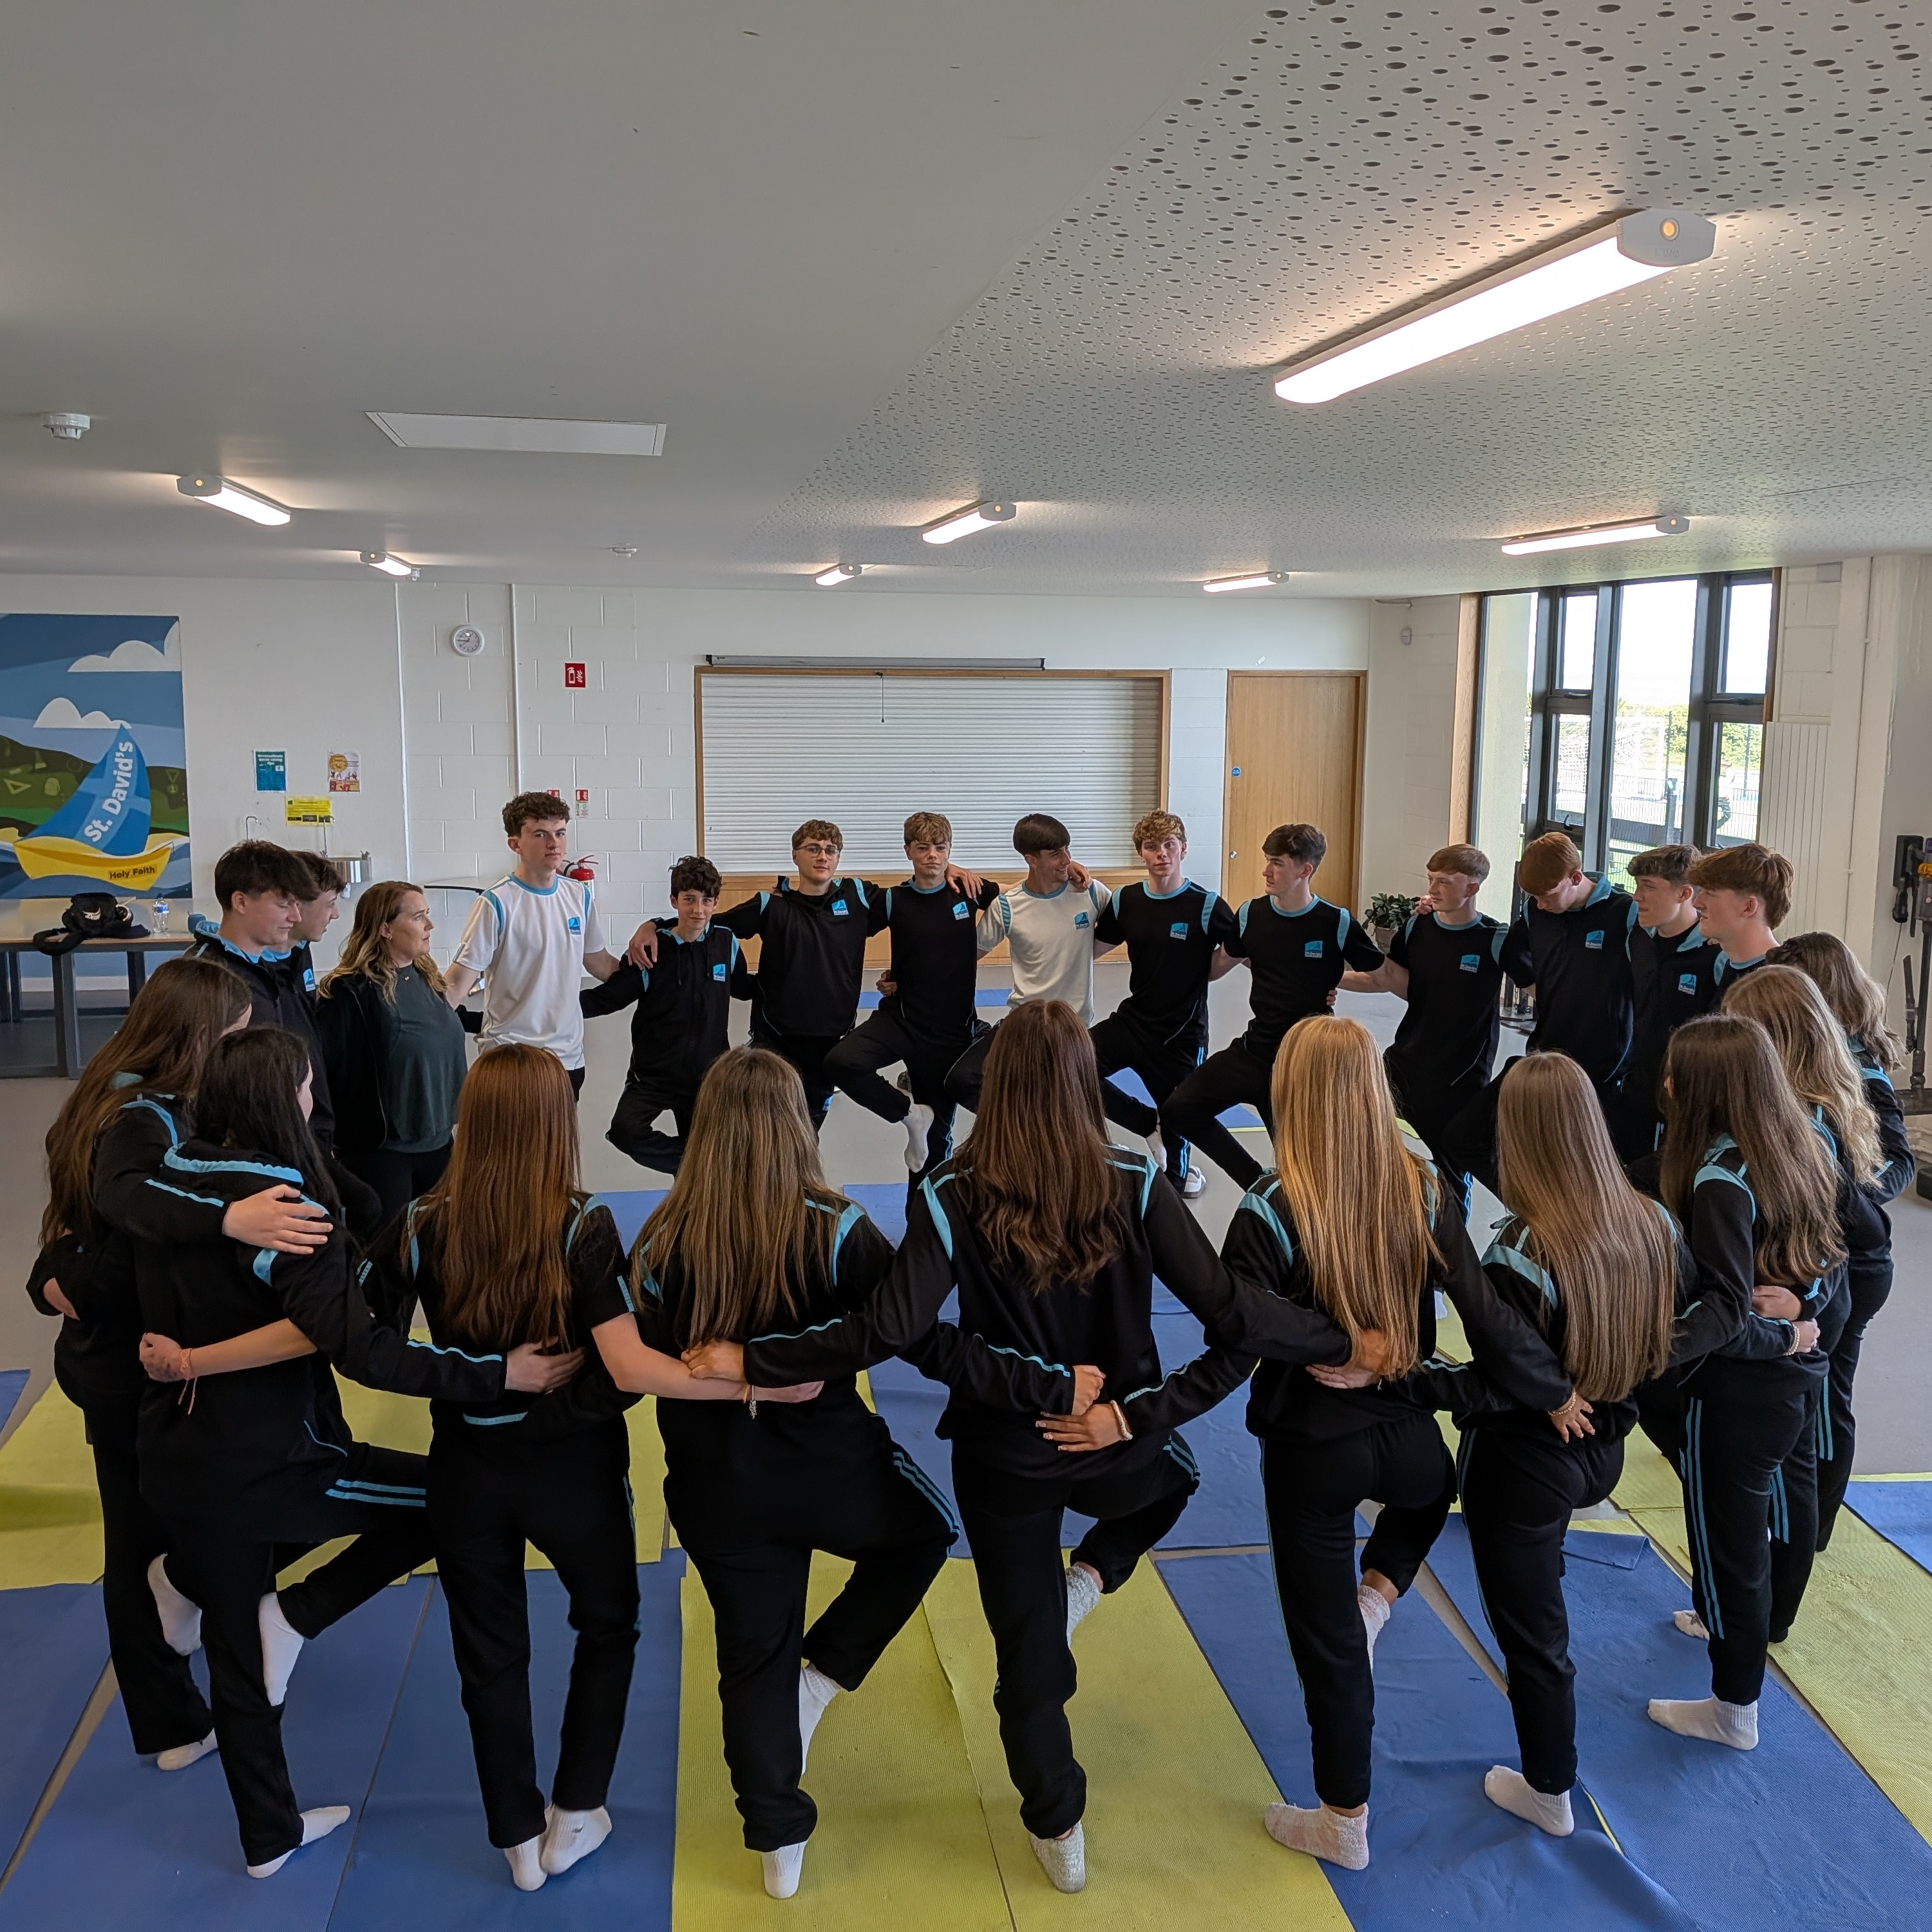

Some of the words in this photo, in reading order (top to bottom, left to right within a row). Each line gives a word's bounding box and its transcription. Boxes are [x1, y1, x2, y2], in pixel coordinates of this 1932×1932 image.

[84, 819, 113, 842] St.
[102, 741, 133, 815] David's
[109, 870, 129, 879] Holy
[132, 866, 155, 876] Faith
